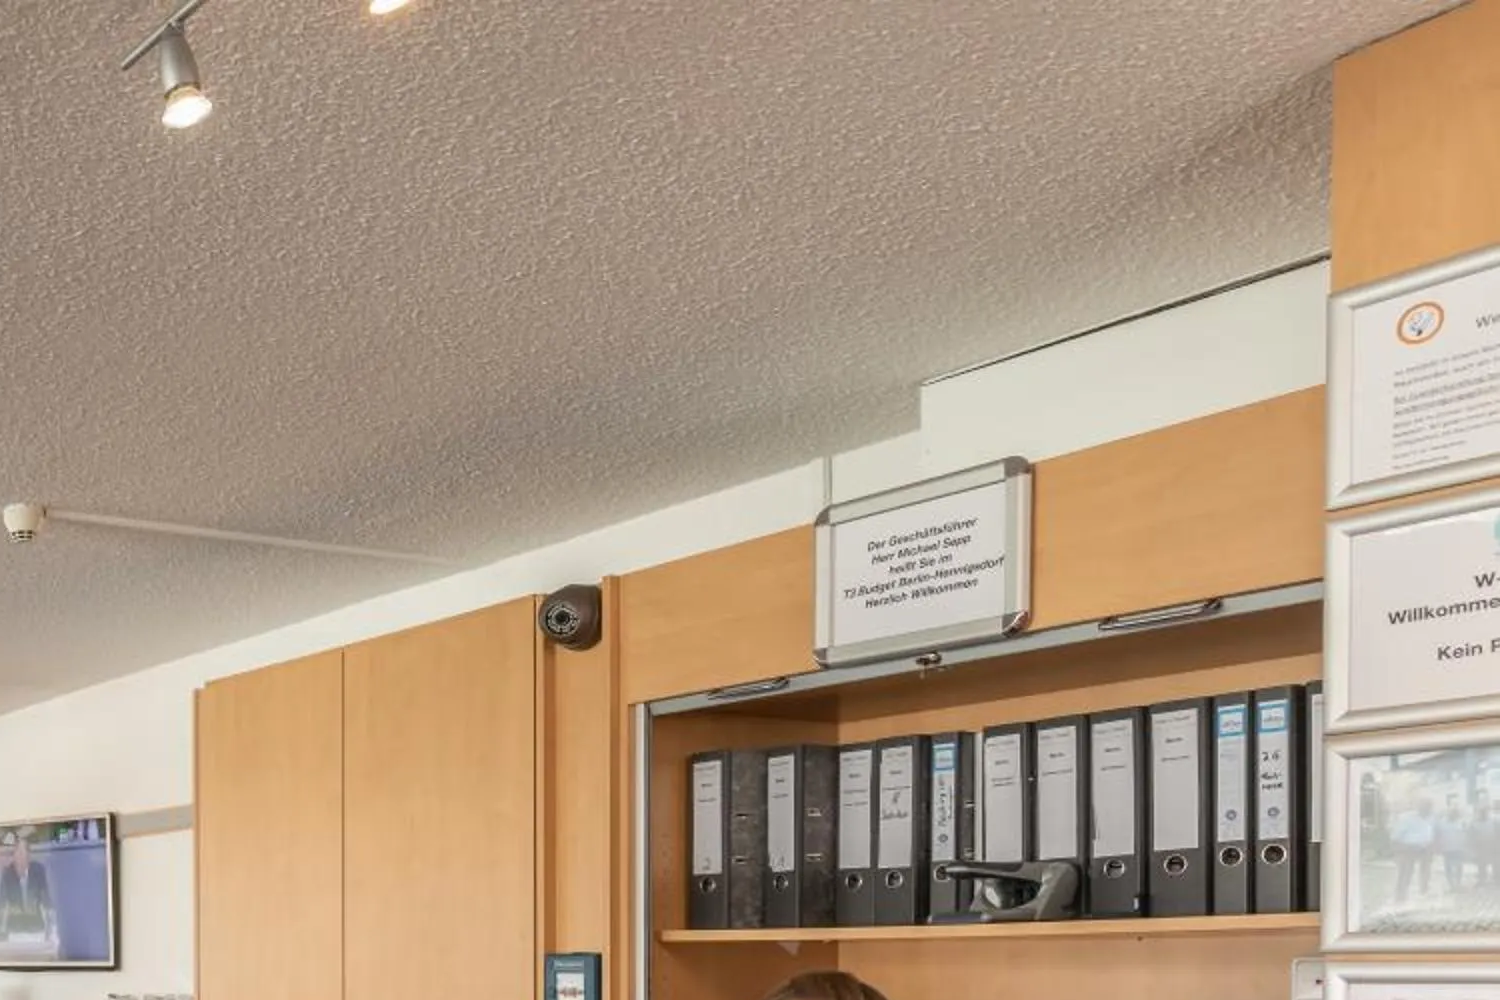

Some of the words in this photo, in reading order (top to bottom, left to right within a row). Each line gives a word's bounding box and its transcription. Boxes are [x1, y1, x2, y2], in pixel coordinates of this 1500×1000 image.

[867, 540, 886, 552] Der
[871, 553, 895, 565] Herr
[897, 540, 940, 558] Michael
[919, 556, 935, 569] Sie
[857, 579, 896, 597] Budget
[865, 590, 908, 609] Herzlich
[911, 577, 979, 600] Willkommen
[1437, 642, 1483, 661] Kein
